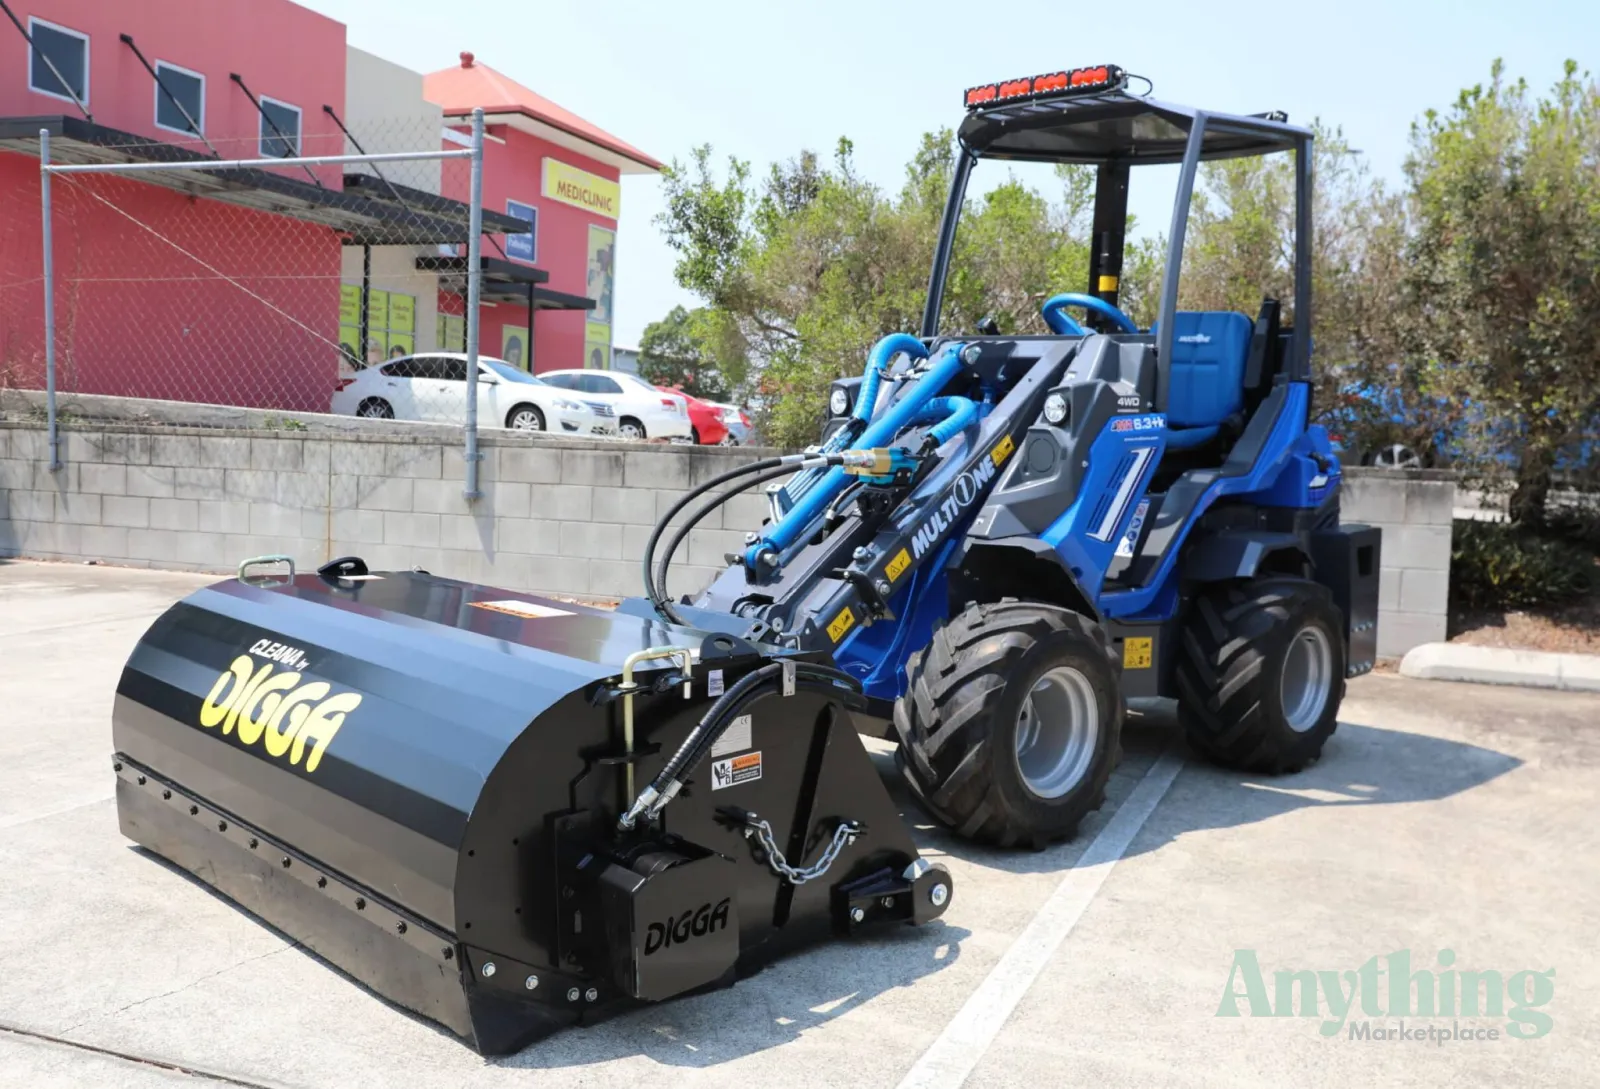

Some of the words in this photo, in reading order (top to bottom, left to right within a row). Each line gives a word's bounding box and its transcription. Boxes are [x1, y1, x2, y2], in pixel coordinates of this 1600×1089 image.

[556, 180, 613, 213] MEDICLINIC
[1117, 397, 1140, 407] 4WD
[249, 639, 305, 666] CLEANA
[200, 655, 362, 773] DIGGA
[644, 897, 731, 956] DIGGA
